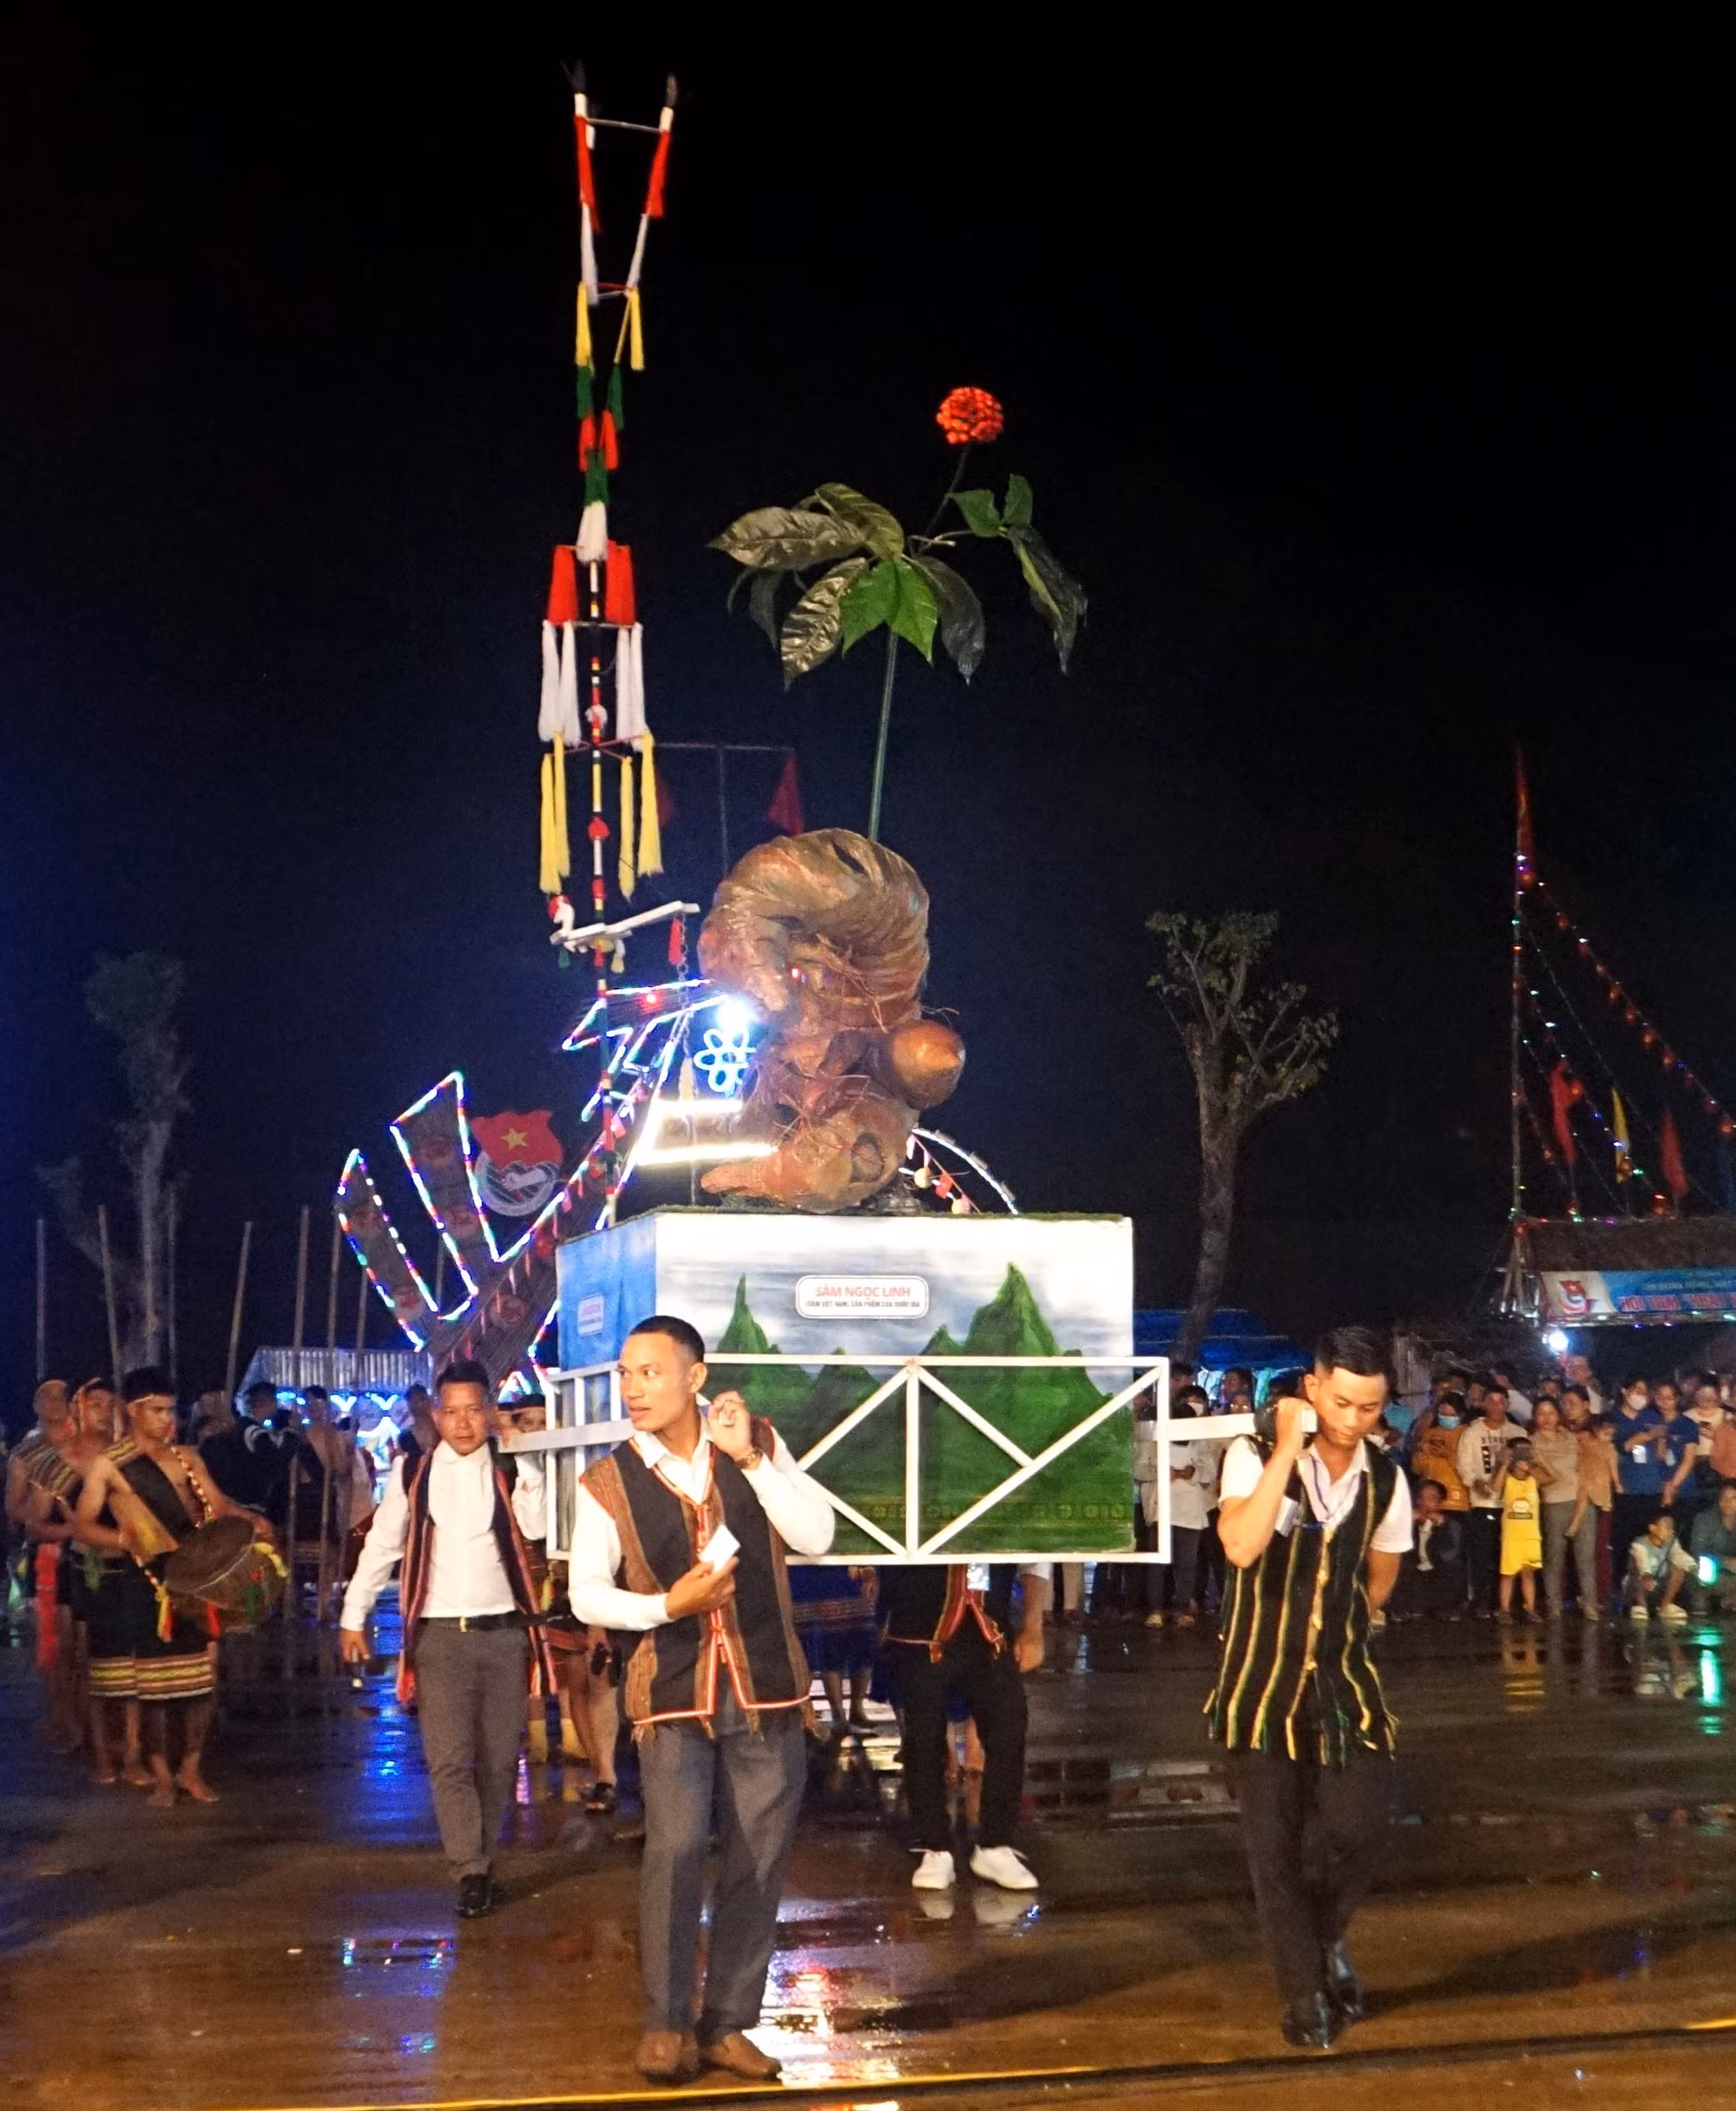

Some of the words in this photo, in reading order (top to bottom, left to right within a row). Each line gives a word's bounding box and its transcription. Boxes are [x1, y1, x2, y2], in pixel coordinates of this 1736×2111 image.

[815, 1284, 841, 1297] SÂM
[845, 1286, 880, 1300] NGỌC
[882, 1286, 911, 1297] LINH
